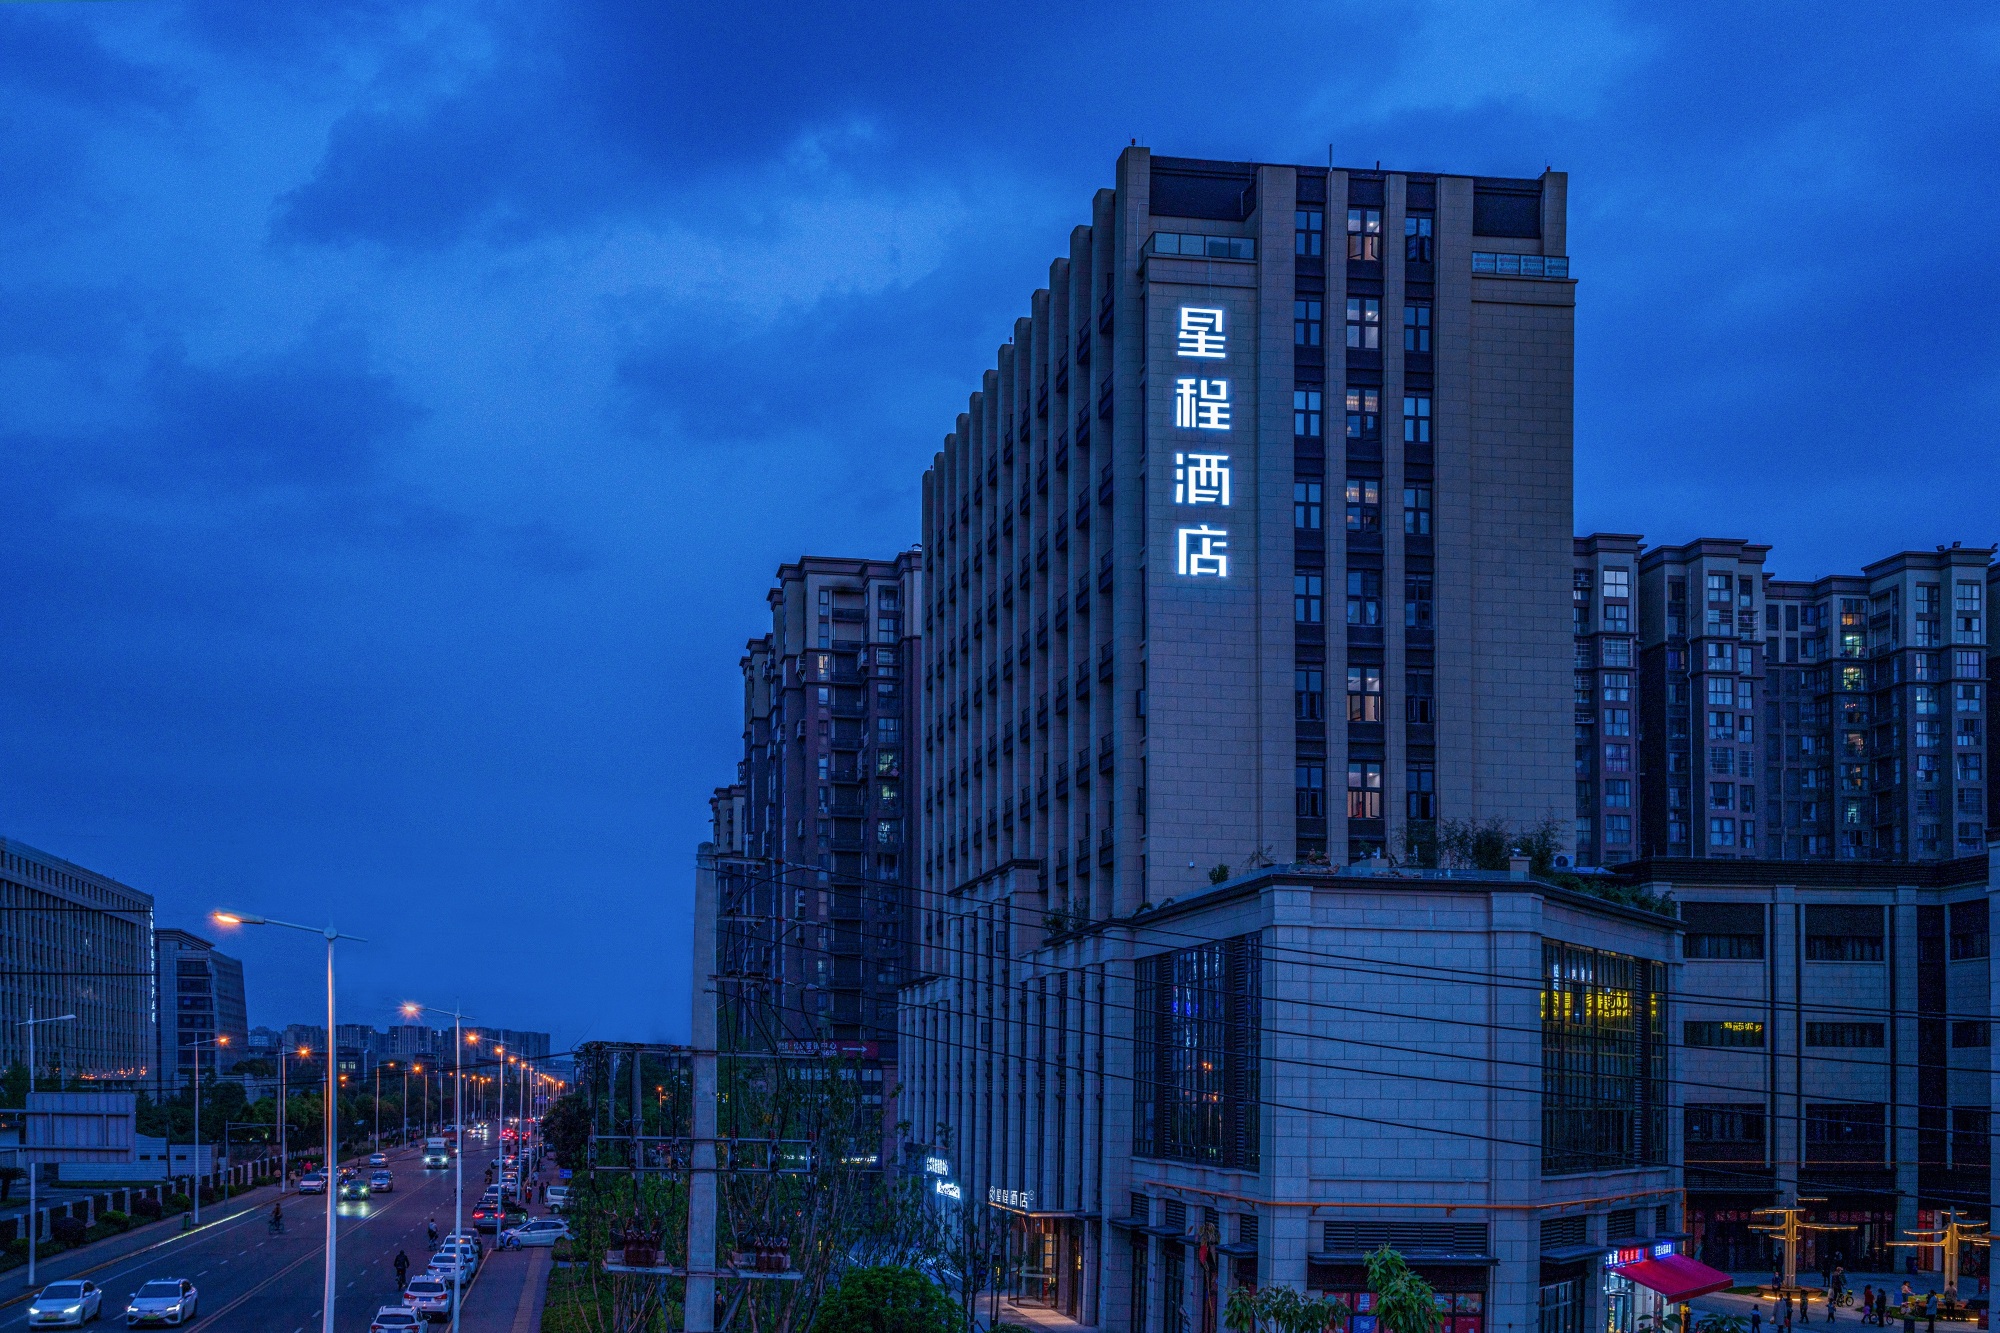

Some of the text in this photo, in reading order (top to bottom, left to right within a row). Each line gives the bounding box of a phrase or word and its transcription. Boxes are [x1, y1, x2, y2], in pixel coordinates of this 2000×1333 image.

[1176, 307, 1230, 577] 星程酒店
[996, 1188, 1028, 1208] 星程酒店
